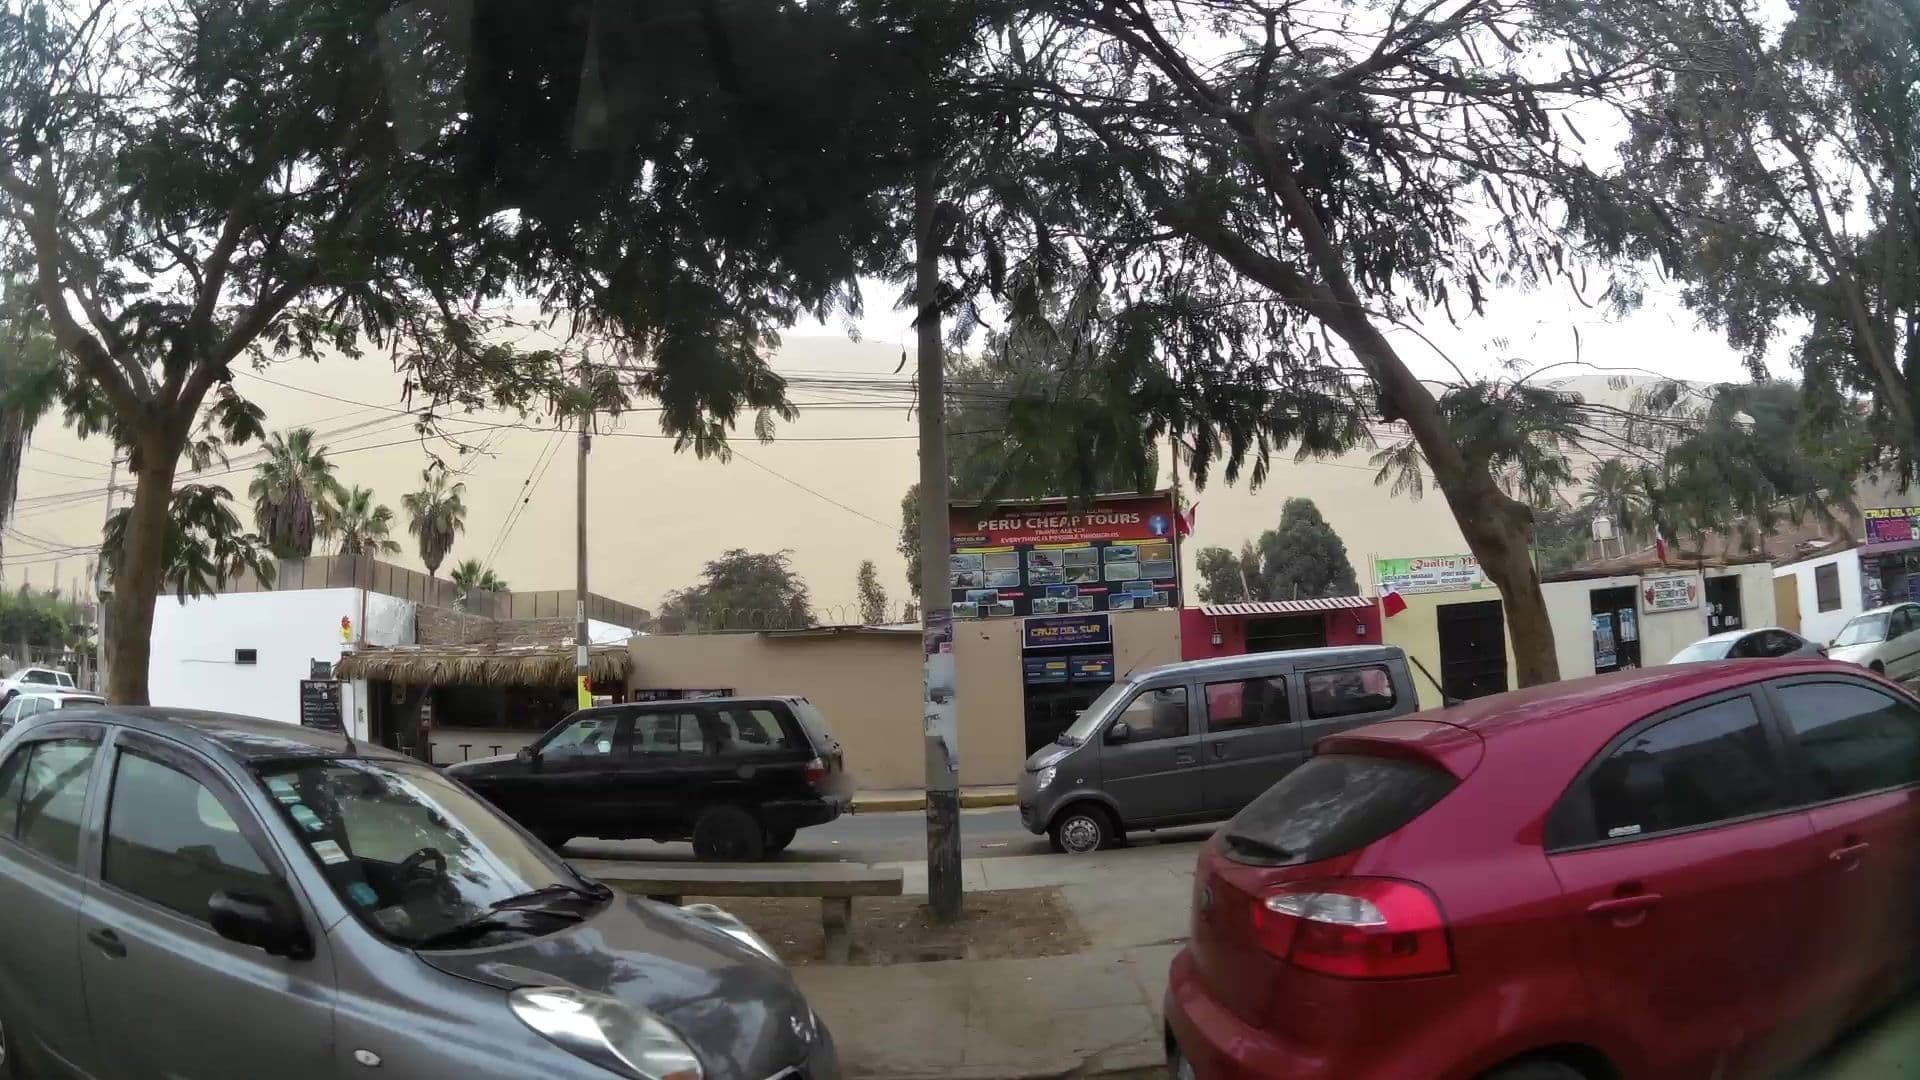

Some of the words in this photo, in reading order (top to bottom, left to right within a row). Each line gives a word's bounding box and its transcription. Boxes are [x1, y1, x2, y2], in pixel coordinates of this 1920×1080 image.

[977, 518, 1021, 532] PERU
[1026, 516, 1081, 529] CHEAP
[1085, 512, 1140, 526] TOURS
[1000, 535, 1040, 545] EVERYTHING
[1409, 558, 1455, 571] Quality
[1461, 557, 1479, 567] M
[1031, 627, 1059, 637] CRUZ
[1059, 626, 1078, 635] DEL
[1079, 624, 1100, 634] SUR
